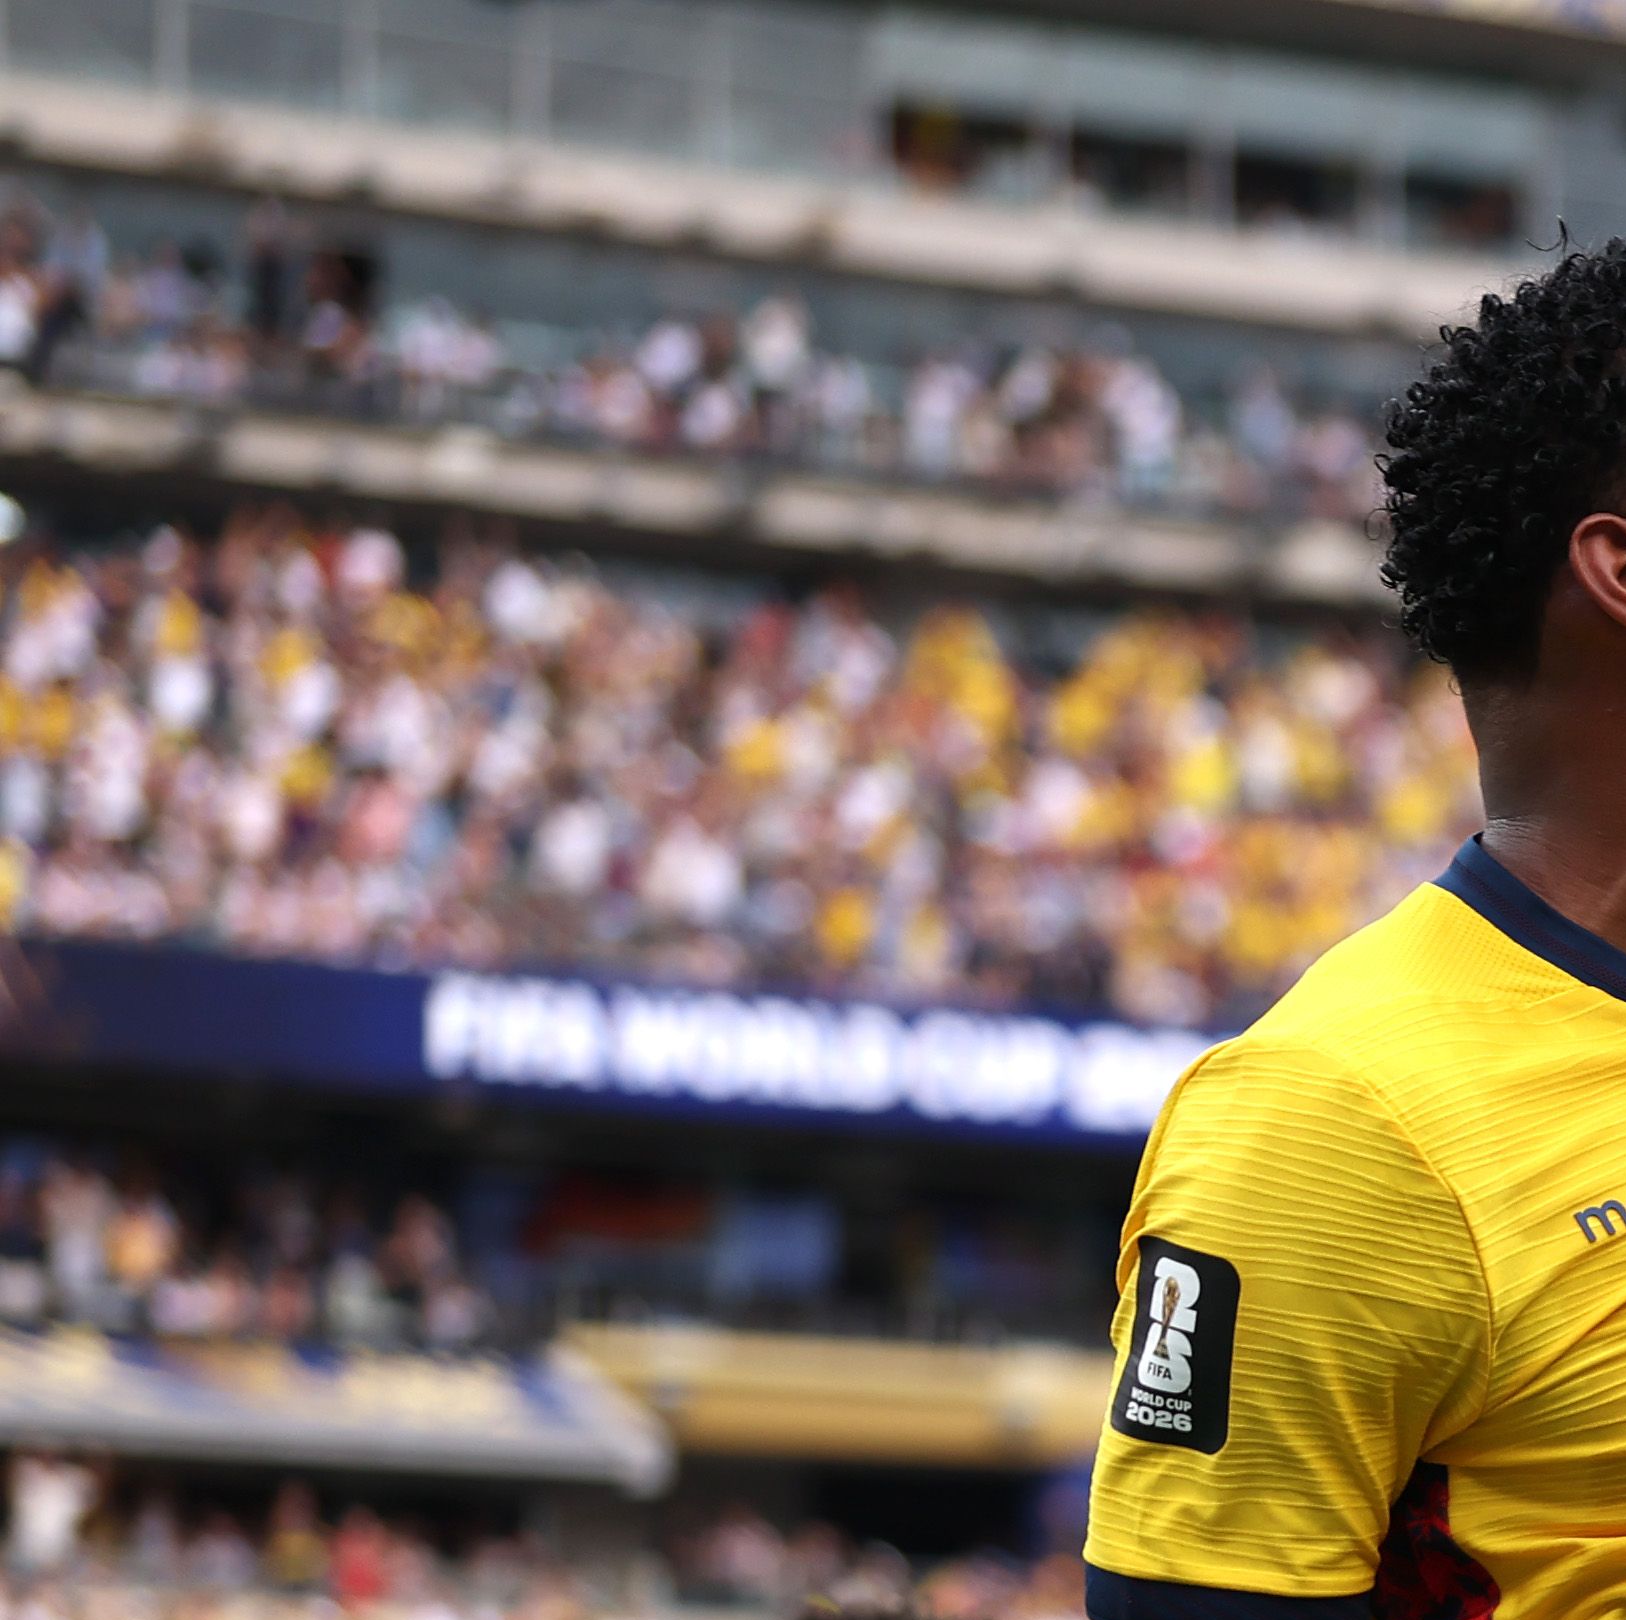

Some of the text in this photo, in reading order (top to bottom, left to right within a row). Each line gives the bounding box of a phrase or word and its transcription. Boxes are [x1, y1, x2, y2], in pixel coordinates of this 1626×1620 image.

[426, 974, 602, 1084] FIFA
[612, 987, 906, 1112] WORLD
[910, 1008, 1066, 1126] CUP
[1147, 1362, 1173, 1380] FIFA
[1131, 1386, 1192, 1412] WORLD CUP
[1125, 1401, 1193, 1432] 2026
